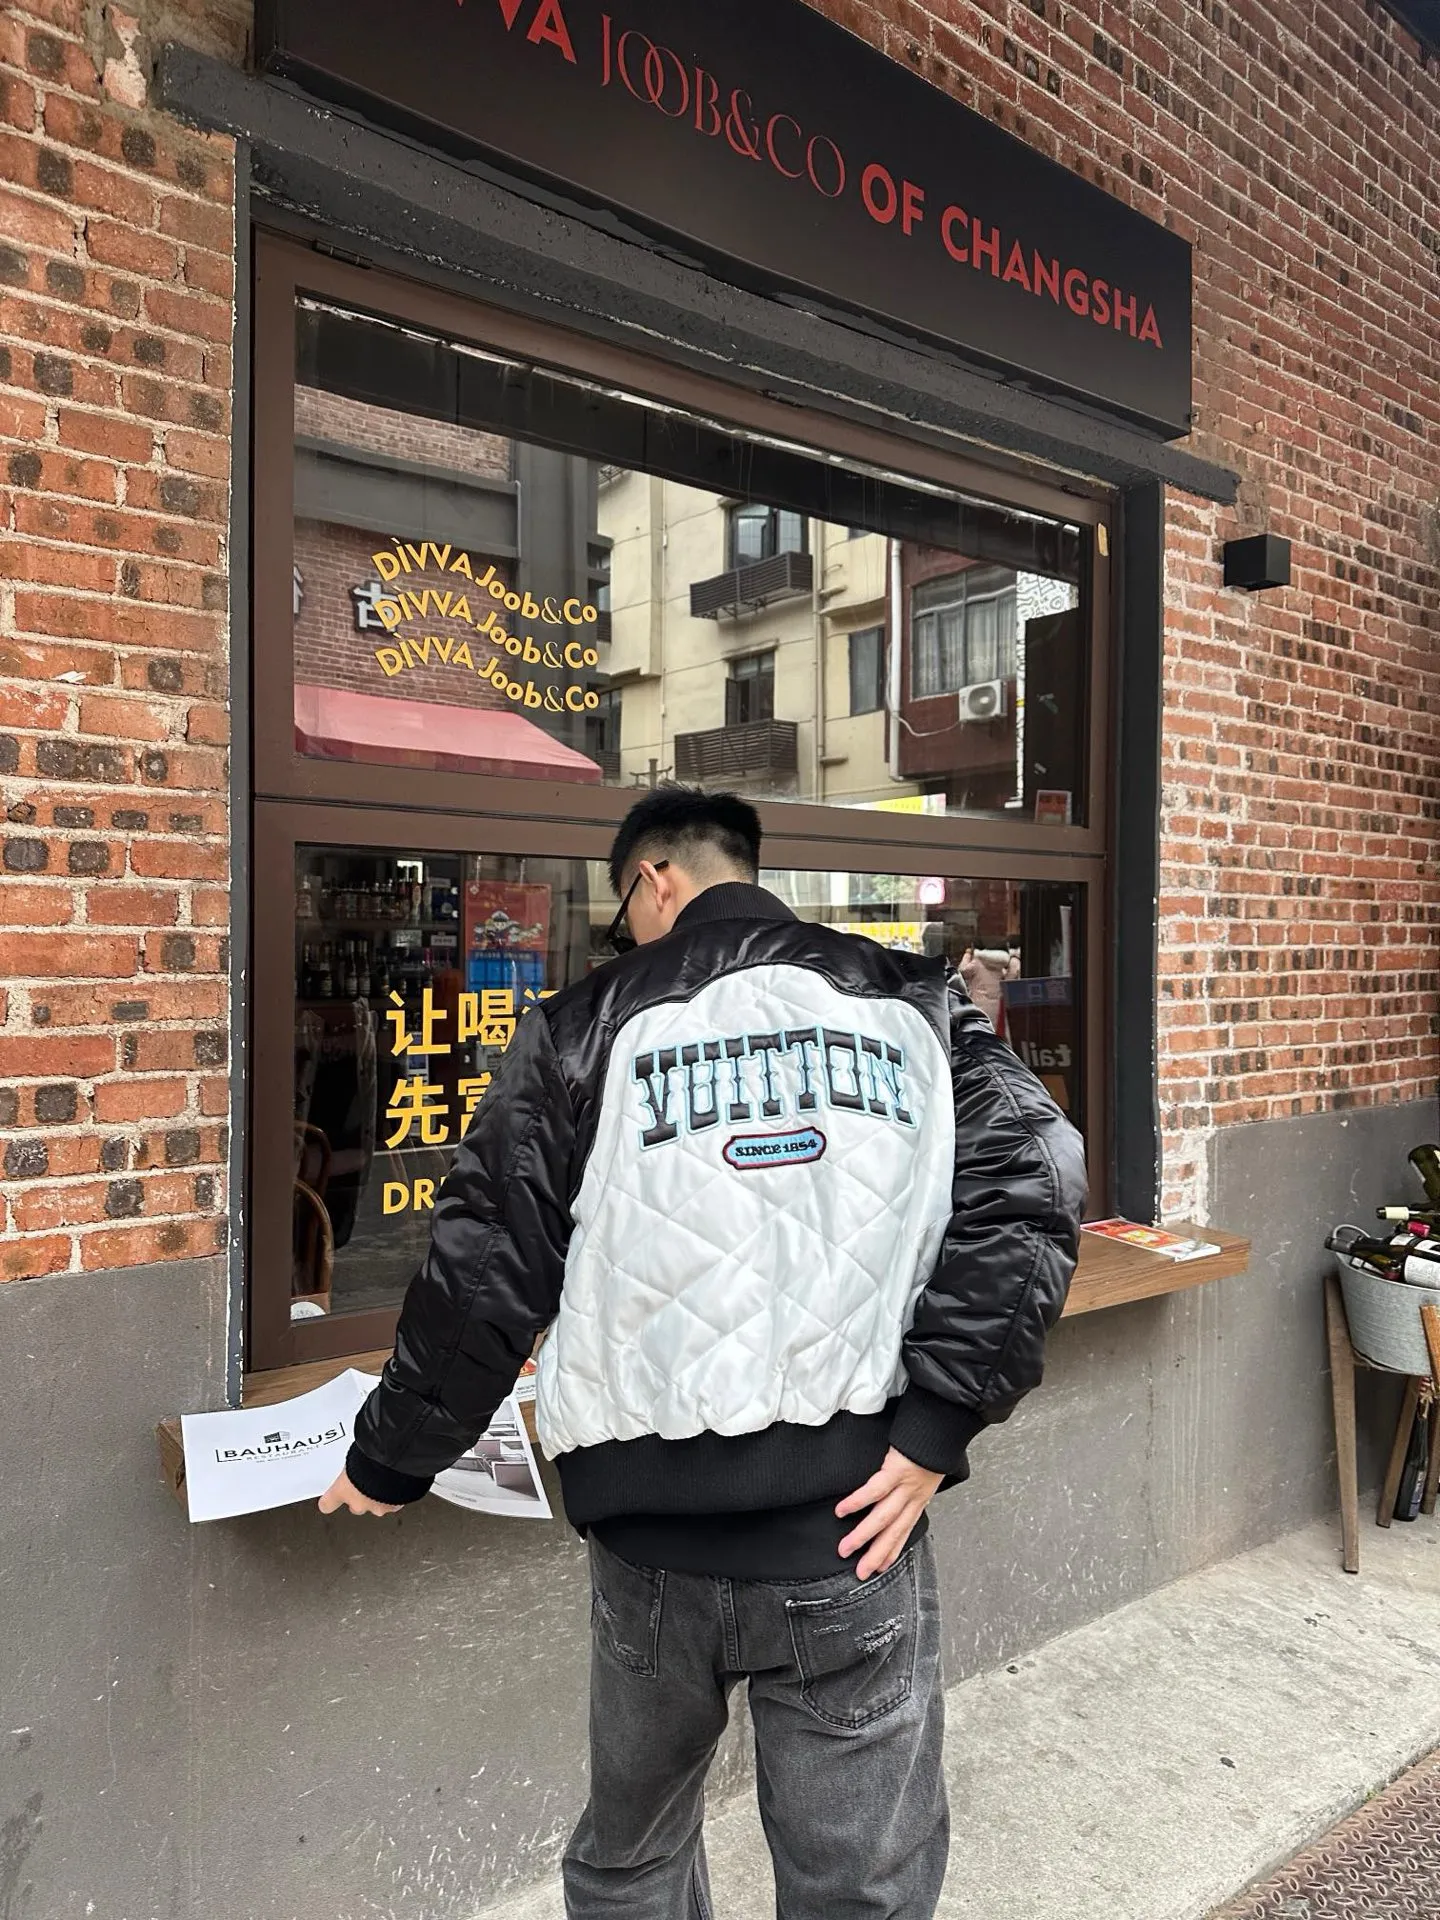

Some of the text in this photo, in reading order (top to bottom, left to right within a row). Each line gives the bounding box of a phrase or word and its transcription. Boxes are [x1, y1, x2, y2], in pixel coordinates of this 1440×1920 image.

[601, 14, 845, 197] JOOB&CO
[861, 163, 925, 236] OF
[941, 206, 1163, 349] CHANGSHA
[386, 988, 559, 1056] 让喝
[631, 1024, 918, 1151] VUITTON
[735, 1138, 818, 1157] SINCE 1854
[383, 1176, 447, 1215] DR
[224, 1429, 338, 1458] BAUHAUS
